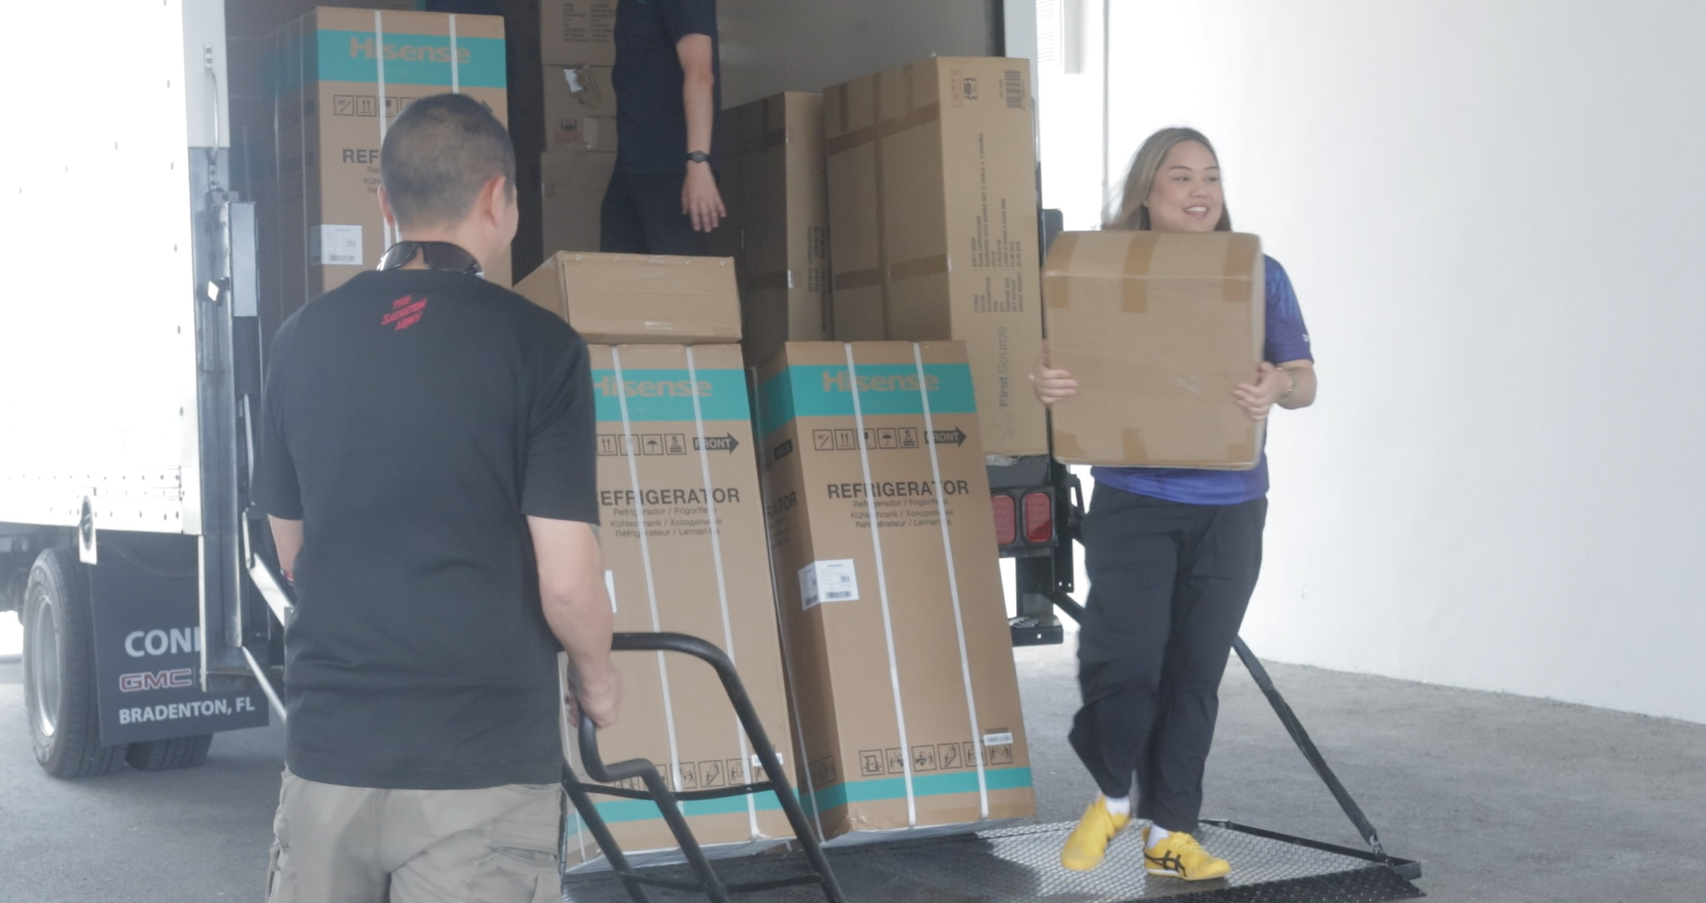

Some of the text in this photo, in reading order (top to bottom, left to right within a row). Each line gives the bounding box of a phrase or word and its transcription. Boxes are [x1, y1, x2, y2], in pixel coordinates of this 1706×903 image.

[392, 294, 413, 309] THE
[119, 668, 193, 692] GMC
[119, 696, 256, 724] BRADENTON, FL
